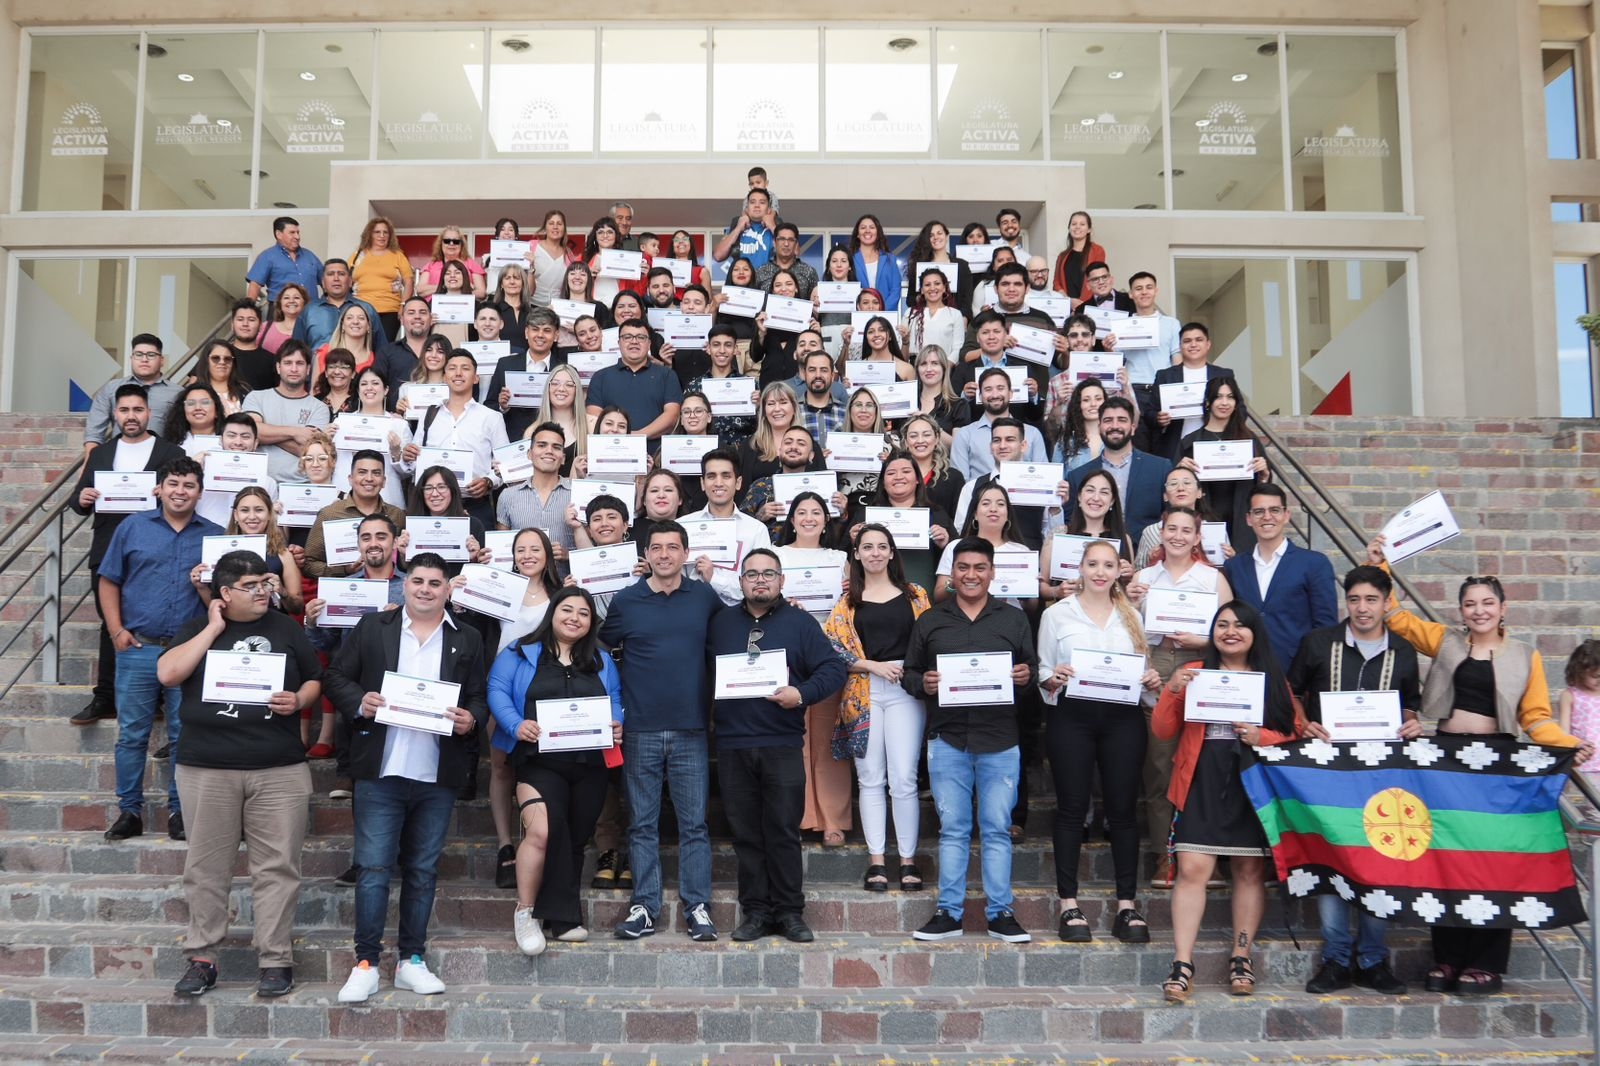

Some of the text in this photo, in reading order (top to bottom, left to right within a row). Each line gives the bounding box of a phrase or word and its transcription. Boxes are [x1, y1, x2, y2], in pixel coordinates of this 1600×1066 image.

[156, 125, 242, 136] LEGISLATURA
[386, 123, 472, 133] LEGISLATURA
[1064, 124, 1150, 134] LEGISLATURA
[52, 134, 108, 145] ACTIVA
[287, 132, 344, 142] ACTIVA
[512, 130, 569, 141] ACTIVA
[737, 130, 794, 140] ACTIVA
[962, 130, 1019, 141] ACTIVA
[1199, 133, 1256, 144] ACTIVA
[1303, 136, 1389, 148] LEGISLATURA
